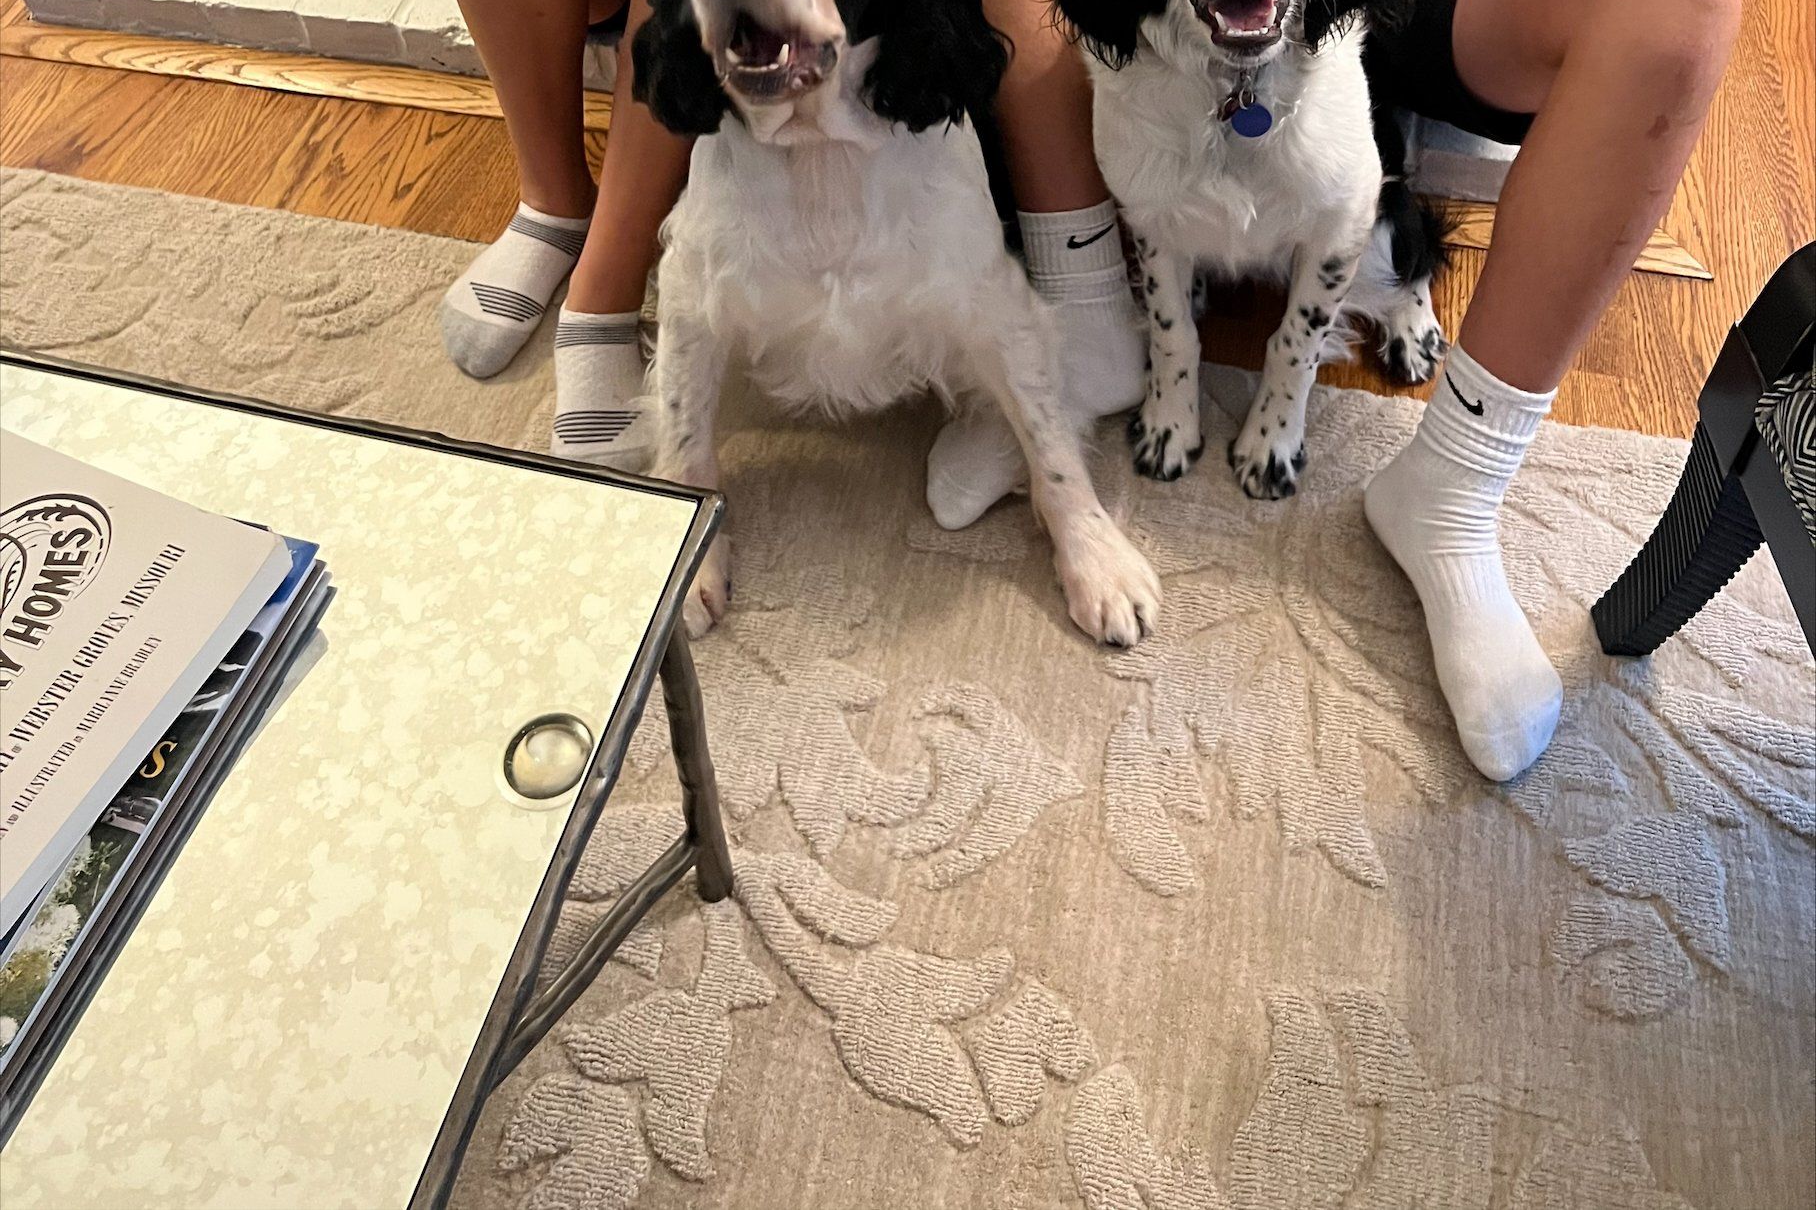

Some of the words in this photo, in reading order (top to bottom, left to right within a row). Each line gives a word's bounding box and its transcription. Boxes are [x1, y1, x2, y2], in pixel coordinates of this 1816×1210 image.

[3, 527, 95, 649] HOMES
[9, 669, 83, 742] WEBSTER
[72, 612, 134, 668] GROVES,
[120, 544, 186, 610] MISSOURI
[11, 741, 77, 812] ILLUSTRATED
[120, 636, 162, 678] BRADLEY
